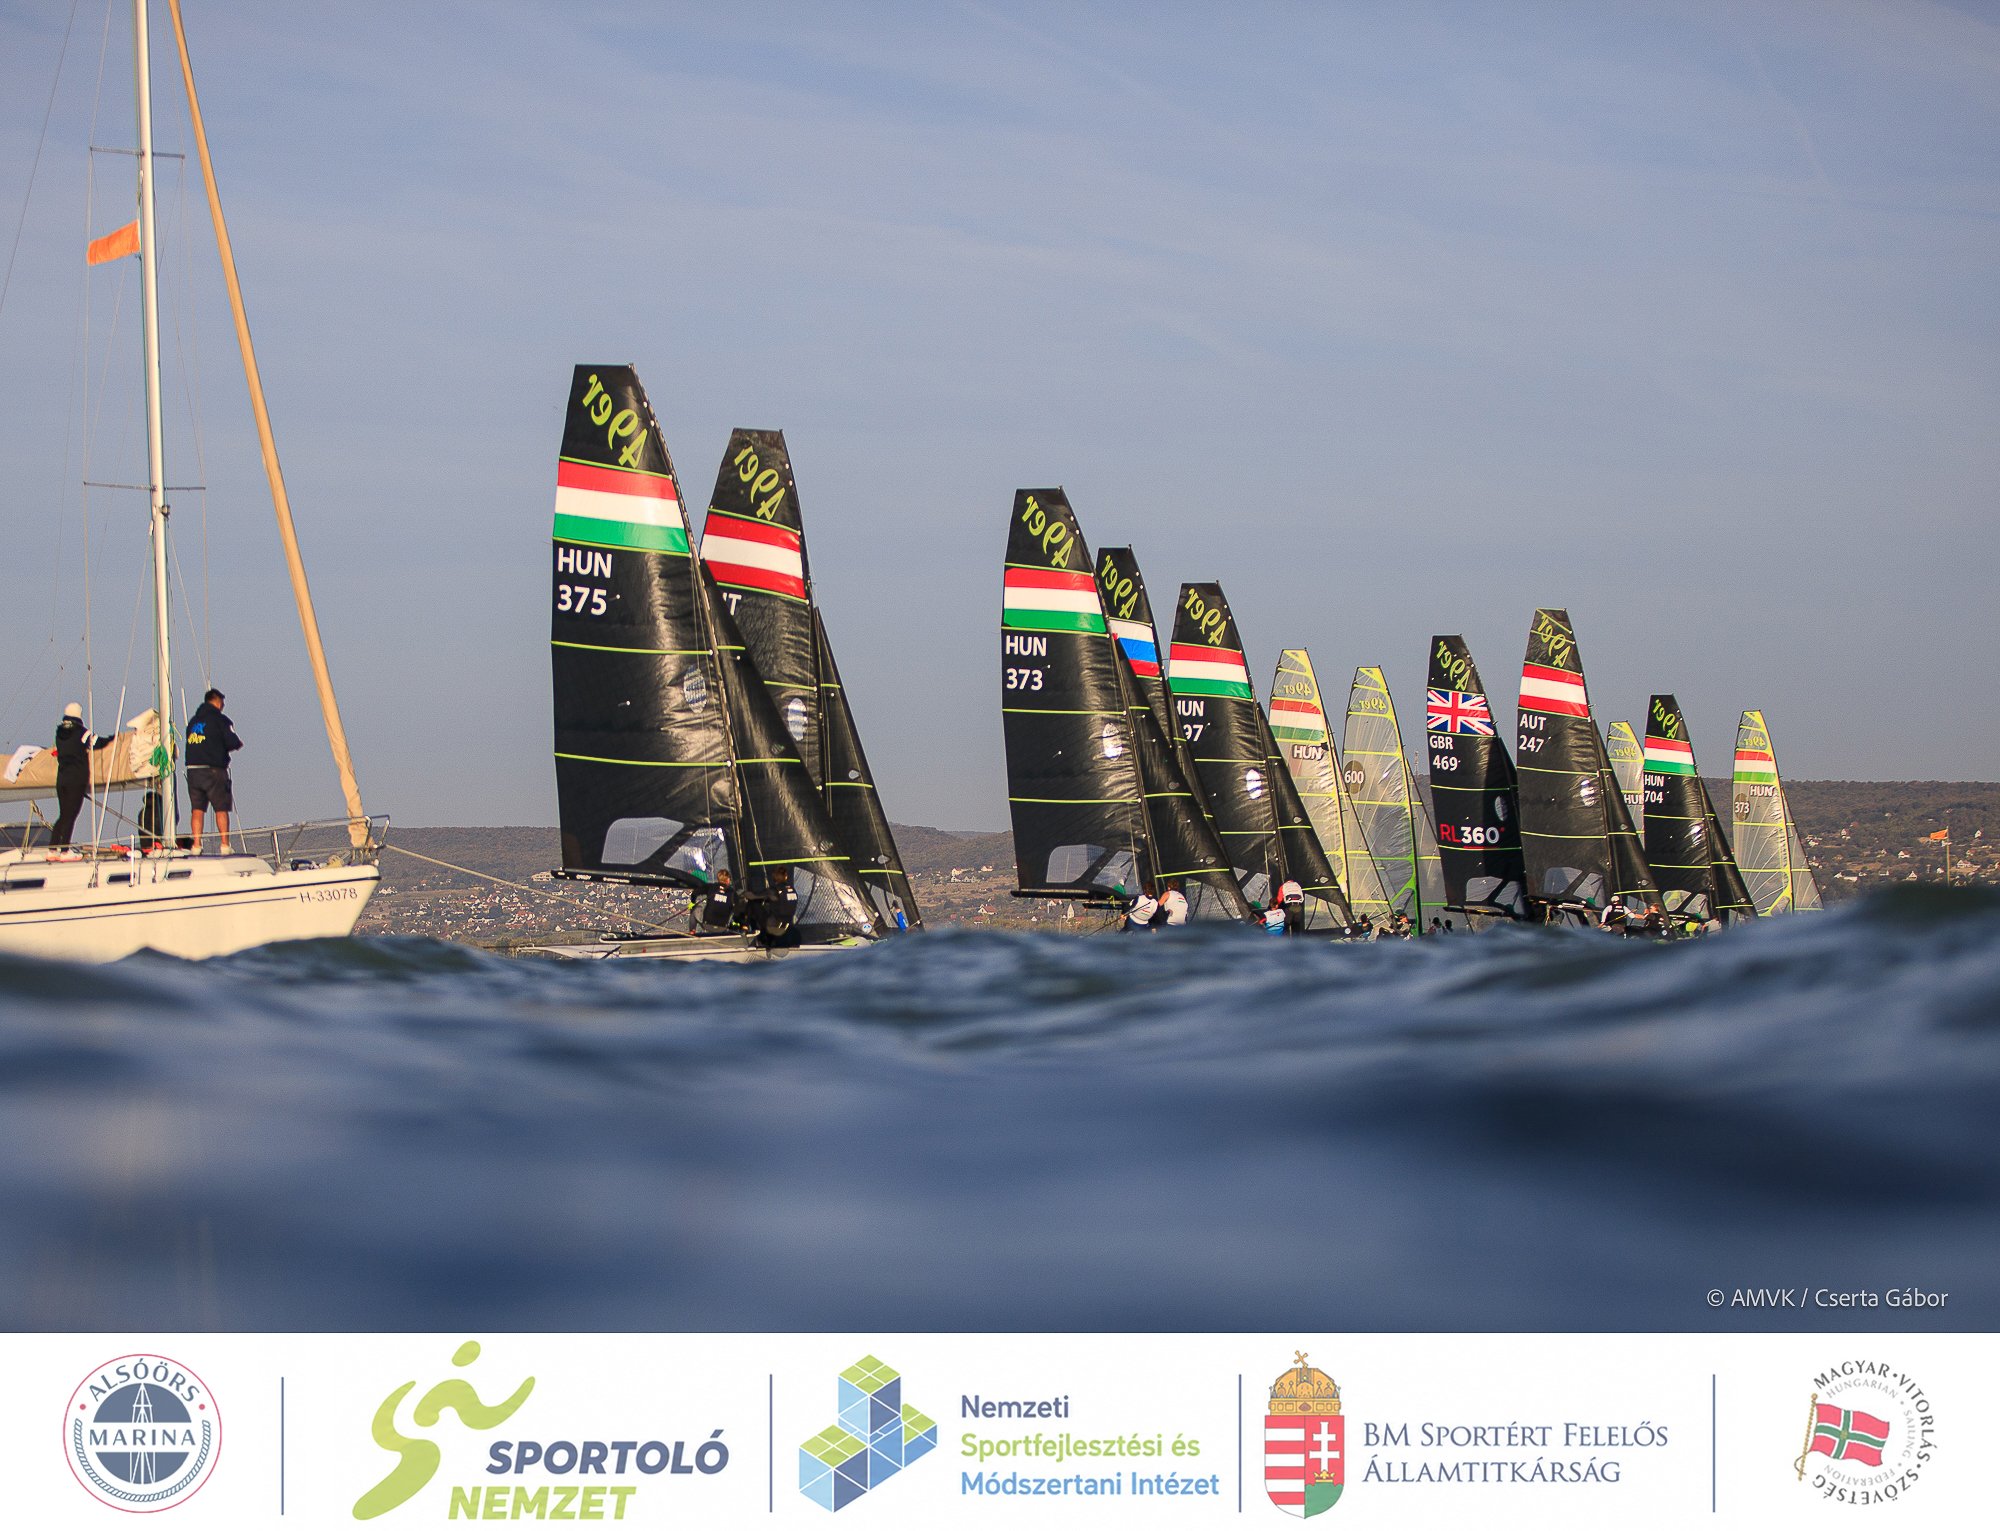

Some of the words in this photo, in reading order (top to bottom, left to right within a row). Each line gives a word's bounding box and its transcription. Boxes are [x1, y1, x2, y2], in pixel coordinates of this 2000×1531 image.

[557, 547, 613, 578] HUN
[557, 584, 607, 616] 375
[1005, 635, 1047, 657] HUN
[1006, 668, 1043, 691] 373
[1519, 714, 1547, 731] AUT
[1183, 724, 1204, 742] 97
[1430, 735, 1454, 750] GBR
[1518, 735, 1544, 753] 247
[1293, 745, 1322, 760] HUN
[1433, 755, 1458, 772] 469
[1344, 770, 1364, 784] 600
[1645, 774, 1665, 788] HUN
[1645, 790, 1664, 804] 704
[1750, 785, 1774, 797] HUN
[1734, 801, 1750, 814] 373
[299, 887, 358, 903] H-33078
